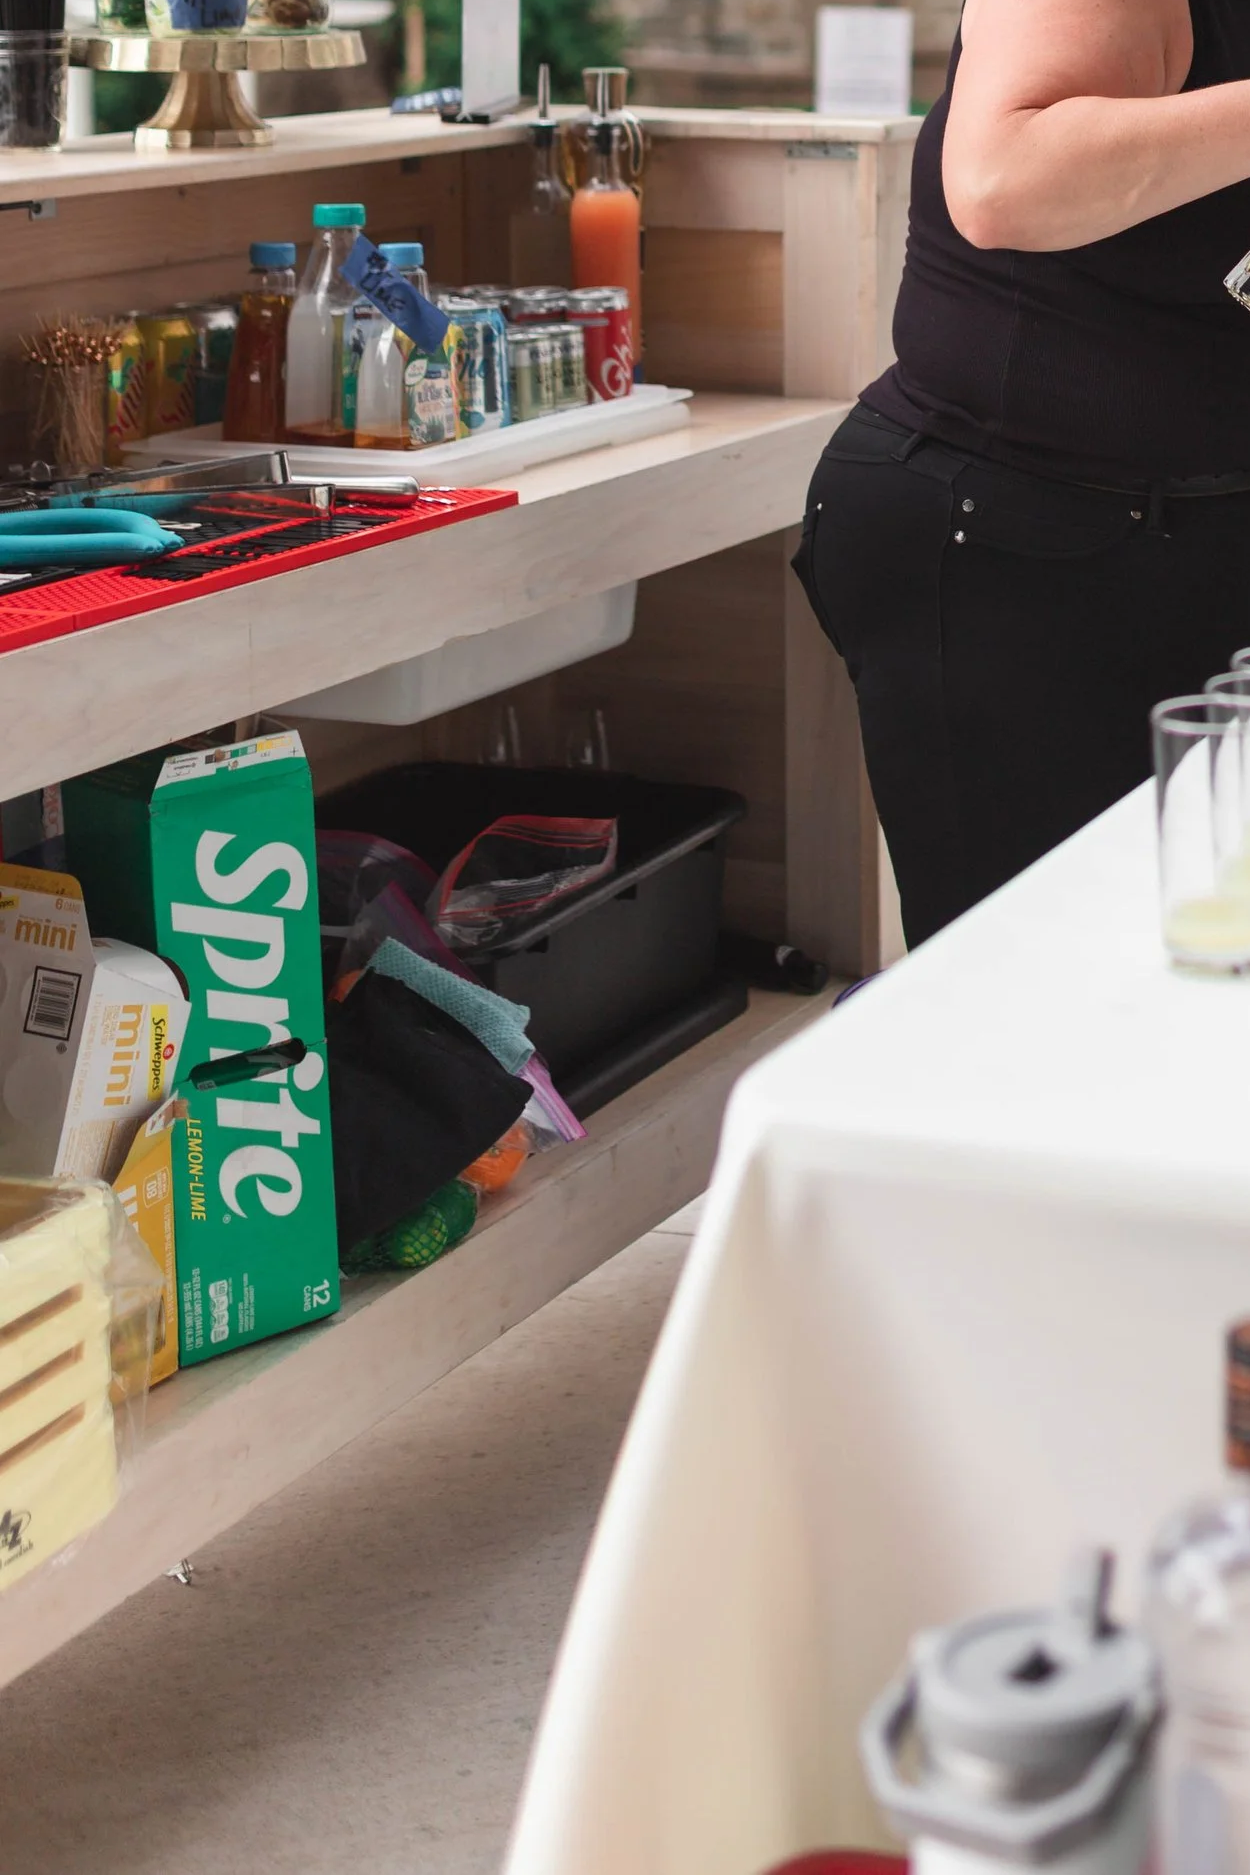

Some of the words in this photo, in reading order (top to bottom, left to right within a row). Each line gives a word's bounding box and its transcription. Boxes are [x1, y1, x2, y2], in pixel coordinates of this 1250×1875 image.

[55, 898, 64, 911] 6
[14, 918, 77, 952] mini
[171, 829, 324, 1219] Sprite
[103, 1004, 144, 1107] mini
[152, 1017, 166, 1093] Schweppes
[186, 1116, 206, 1221] LEMON-LIME
[303, 1285, 312, 1312] CANS
[312, 1279, 331, 1308] 12
